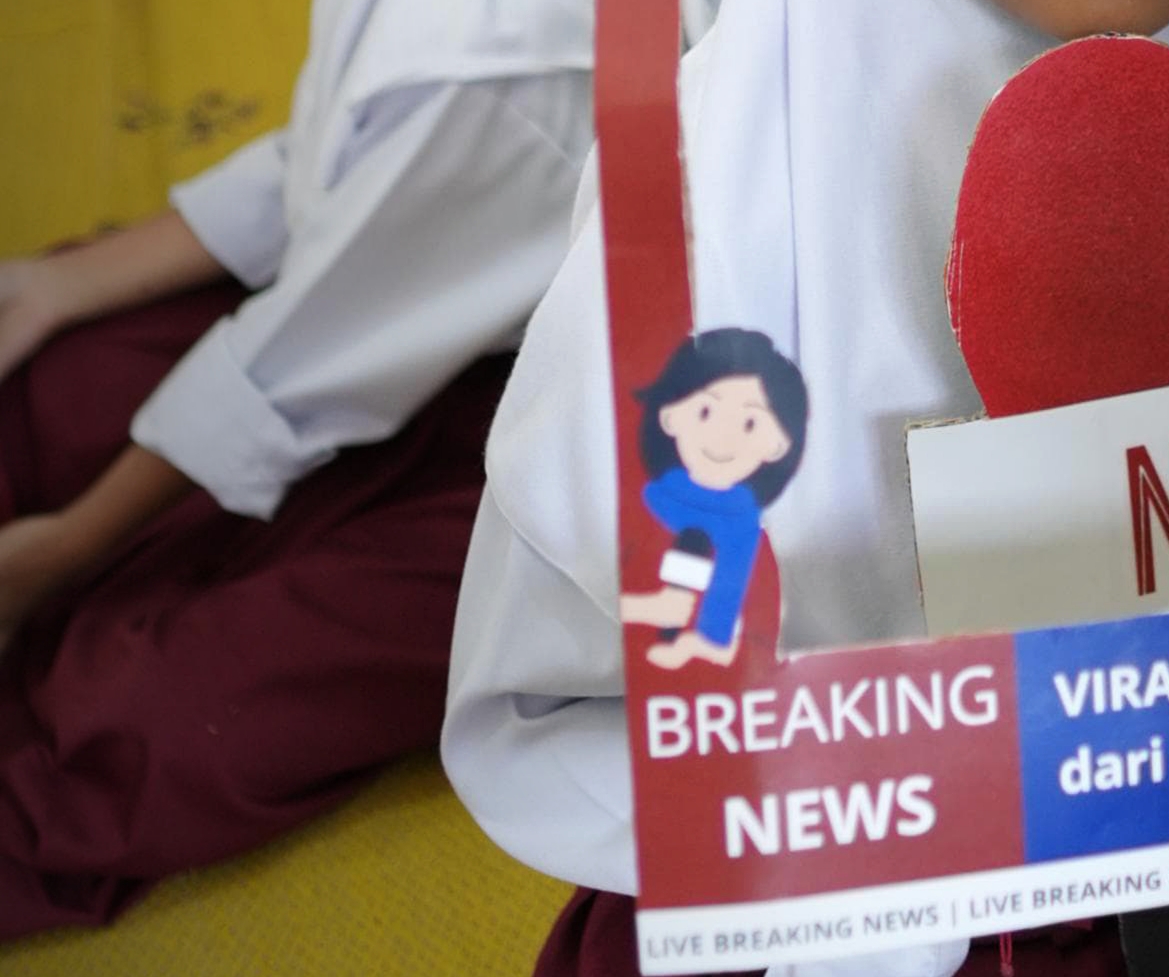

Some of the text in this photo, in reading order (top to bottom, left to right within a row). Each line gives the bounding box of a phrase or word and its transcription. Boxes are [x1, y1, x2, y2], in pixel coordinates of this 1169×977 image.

[645, 665, 998, 759] BREAKING
[1059, 737, 1164, 795] dari
[724, 775, 937, 859] NEWS
[647, 934, 702, 959] LIVE
[713, 919, 853, 954] BREAKING
[862, 905, 939, 935] NEWS
[969, 891, 1023, 920] LIVE
[1032, 870, 1162, 910] BREAKING
